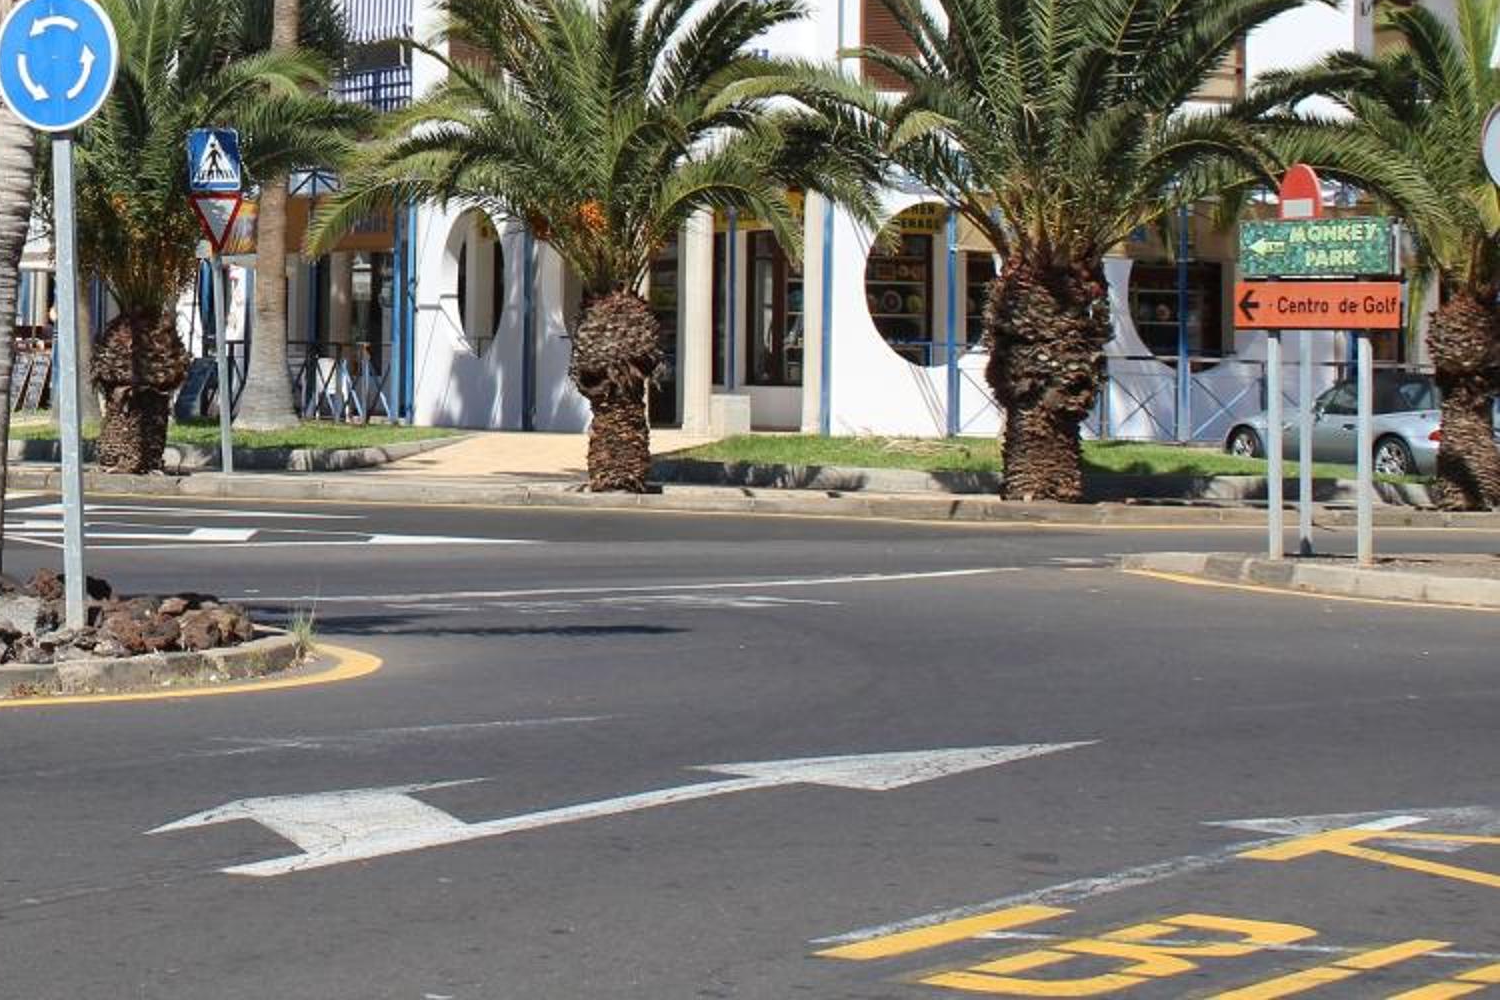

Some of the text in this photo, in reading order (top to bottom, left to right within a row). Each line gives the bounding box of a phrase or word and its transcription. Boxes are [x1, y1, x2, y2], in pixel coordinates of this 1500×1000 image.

[1289, 223, 1377, 243] MONKEY
[1305, 250, 1358, 267] PARK
[1277, 295, 1397, 314] Centro de Golf
